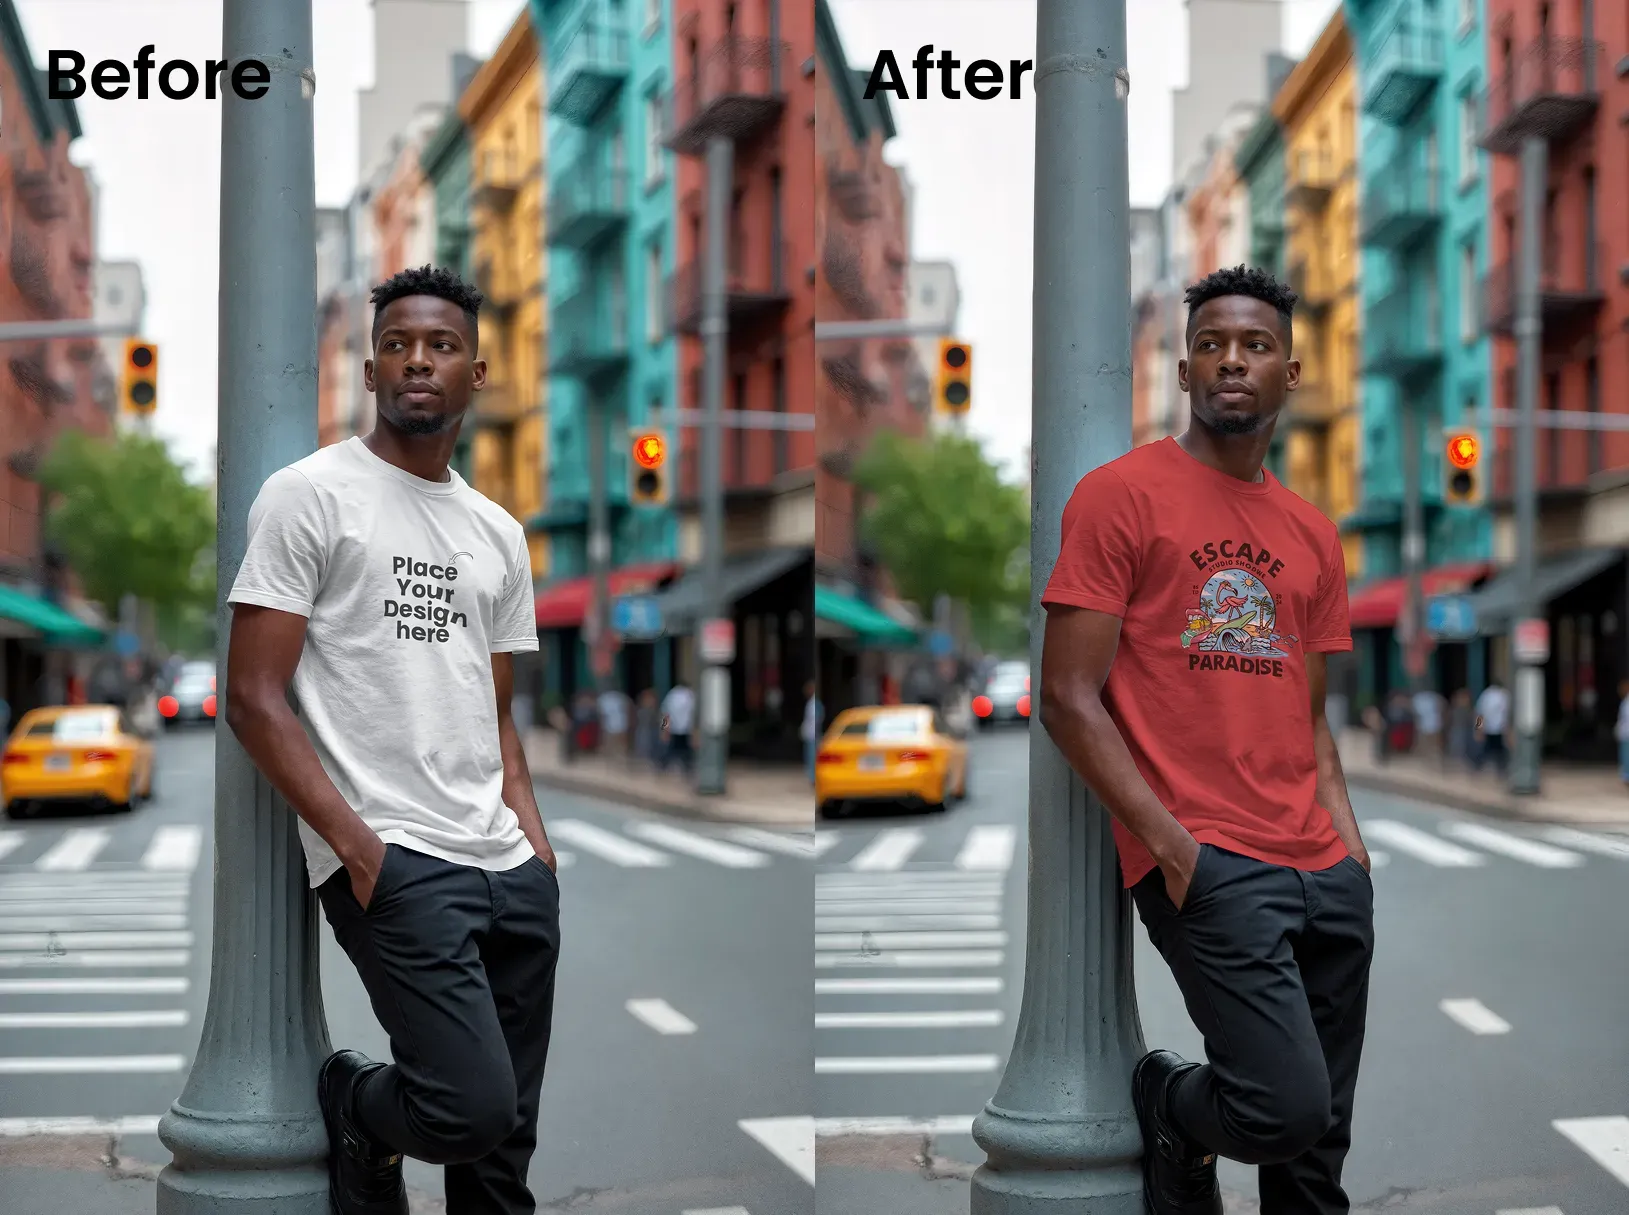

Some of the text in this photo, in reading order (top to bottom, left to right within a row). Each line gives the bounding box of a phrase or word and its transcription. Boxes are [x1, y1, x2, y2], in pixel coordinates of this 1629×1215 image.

[392, 556, 458, 581] Place
[1189, 539, 1285, 578] ESCAPE
[1208, 559, 1267, 580] STUDIO SHODWE
[396, 578, 455, 604] Your
[384, 599, 467, 628] Design
[396, 620, 450, 643] here
[1189, 653, 1284, 678] PARADISE
